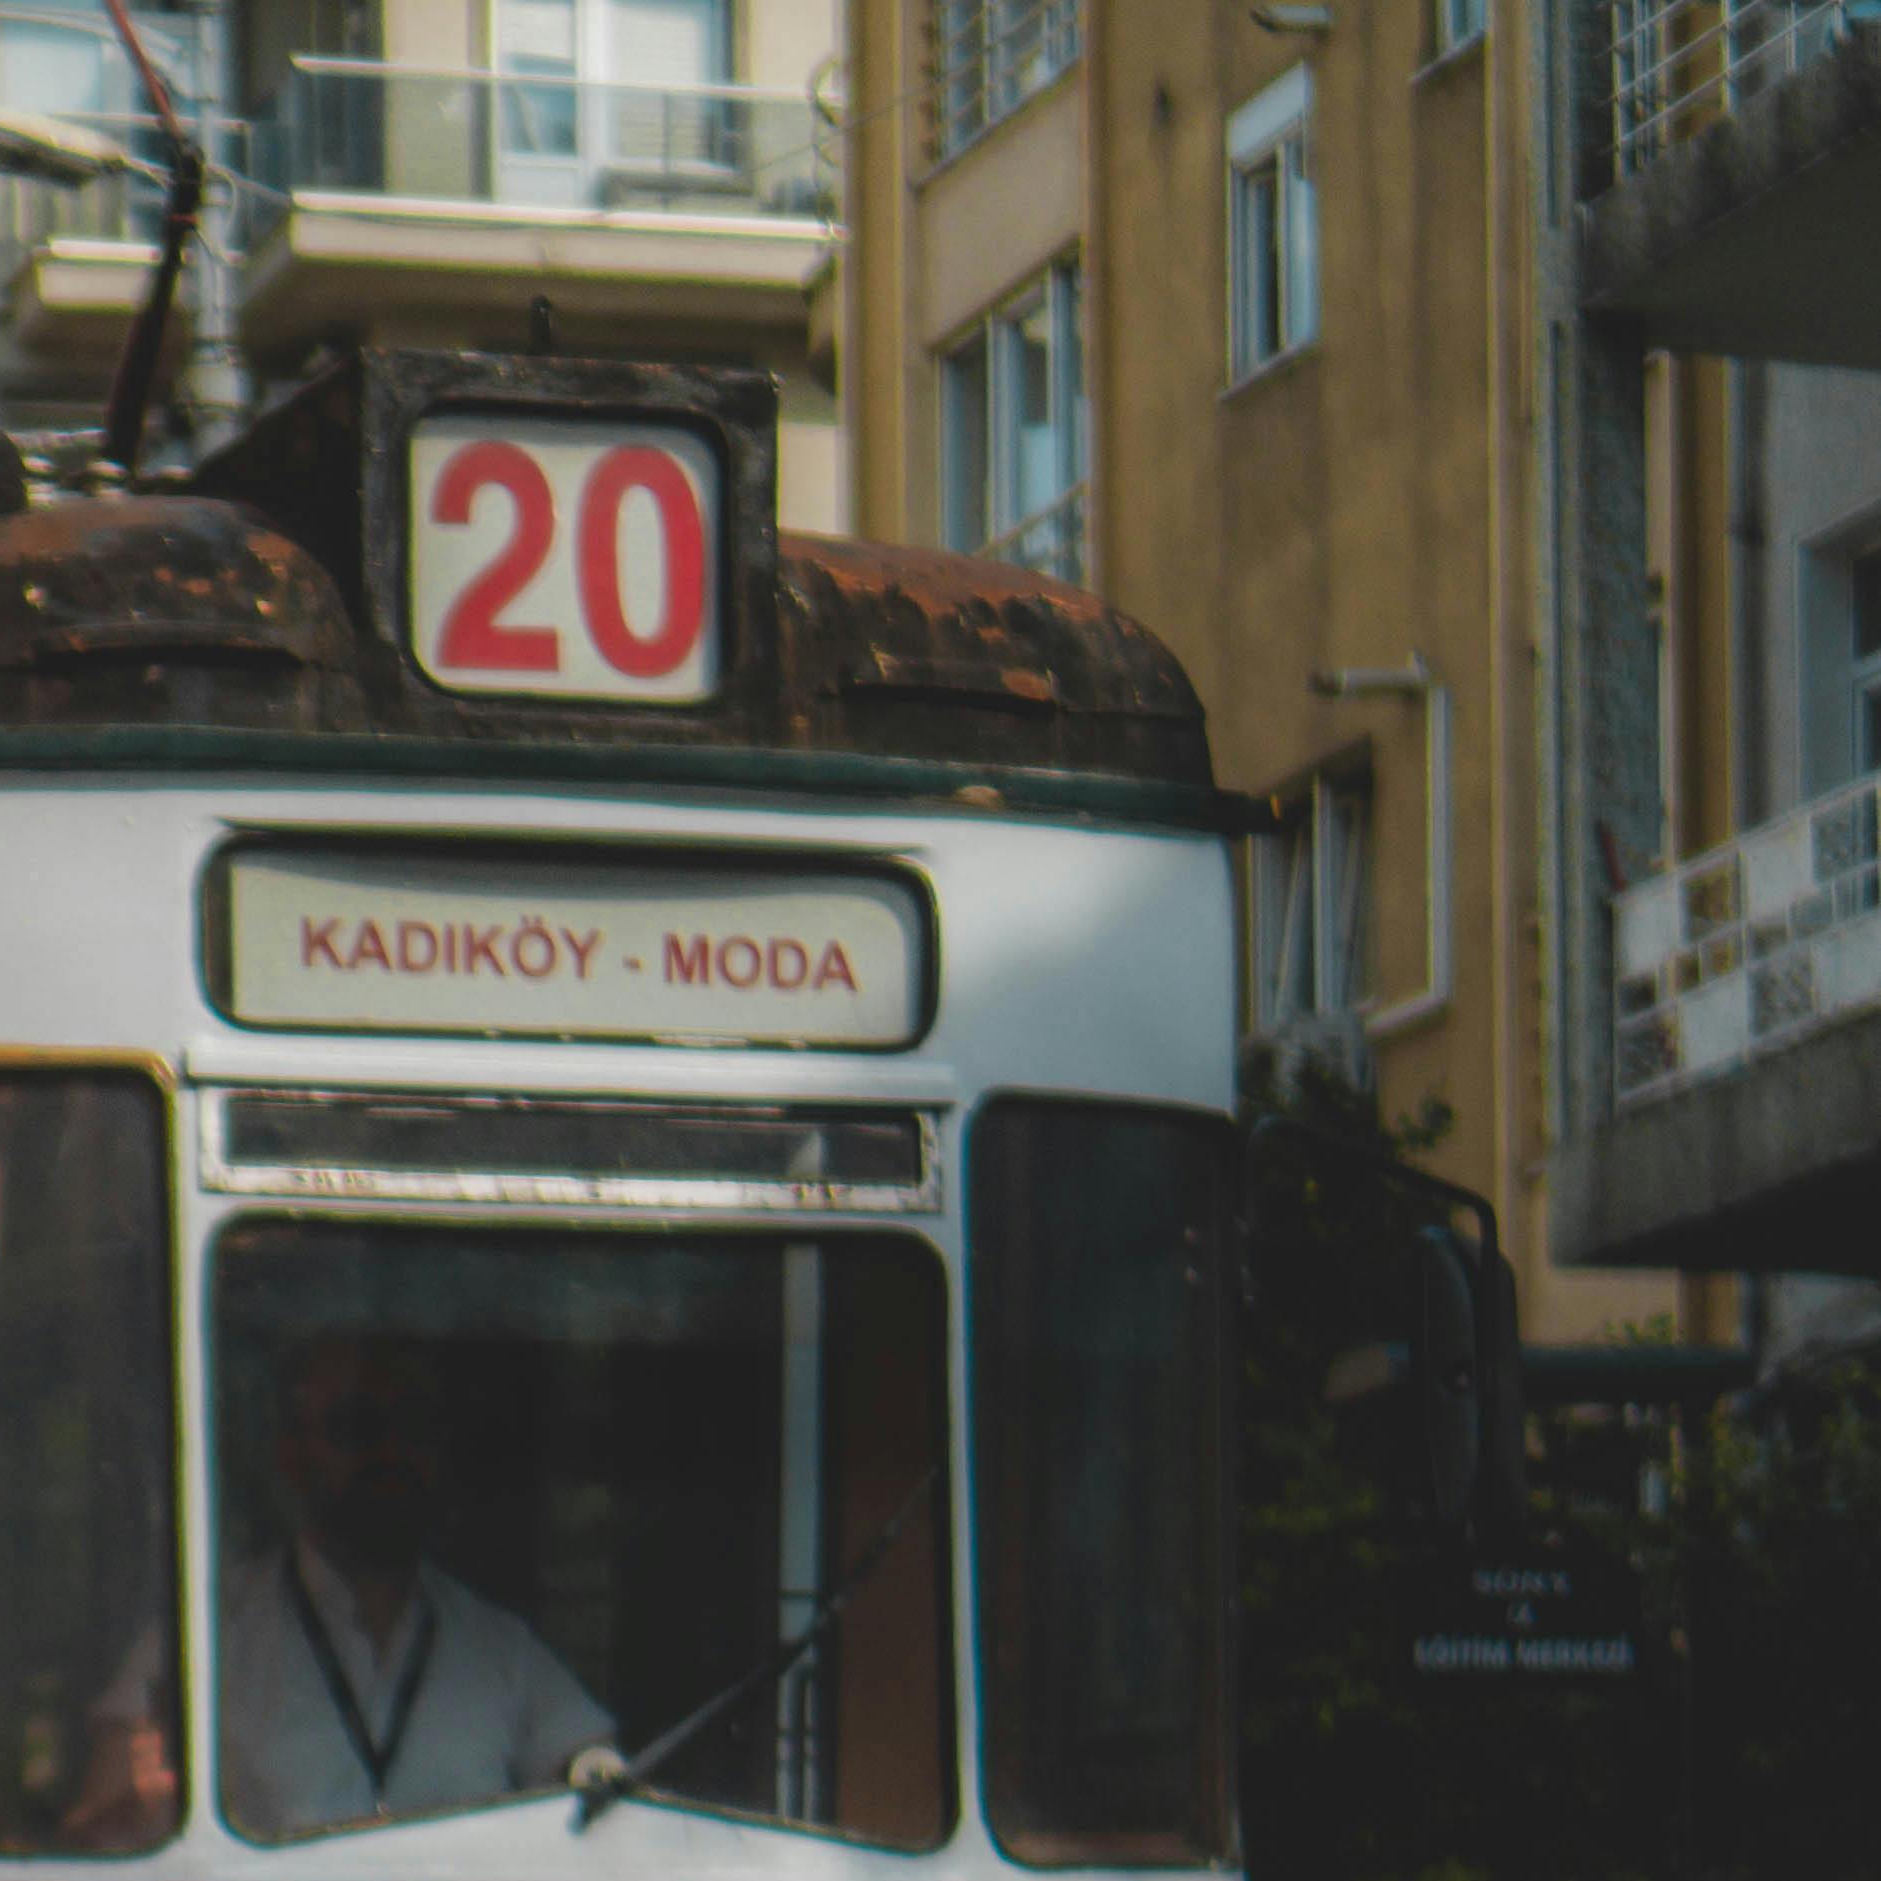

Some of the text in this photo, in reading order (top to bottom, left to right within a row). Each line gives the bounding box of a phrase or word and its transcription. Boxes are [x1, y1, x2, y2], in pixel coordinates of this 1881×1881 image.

[429, 440, 705, 679] 20
[299, 915, 602, 980] KADIKÖY
[663, 933, 859, 993] MODA
